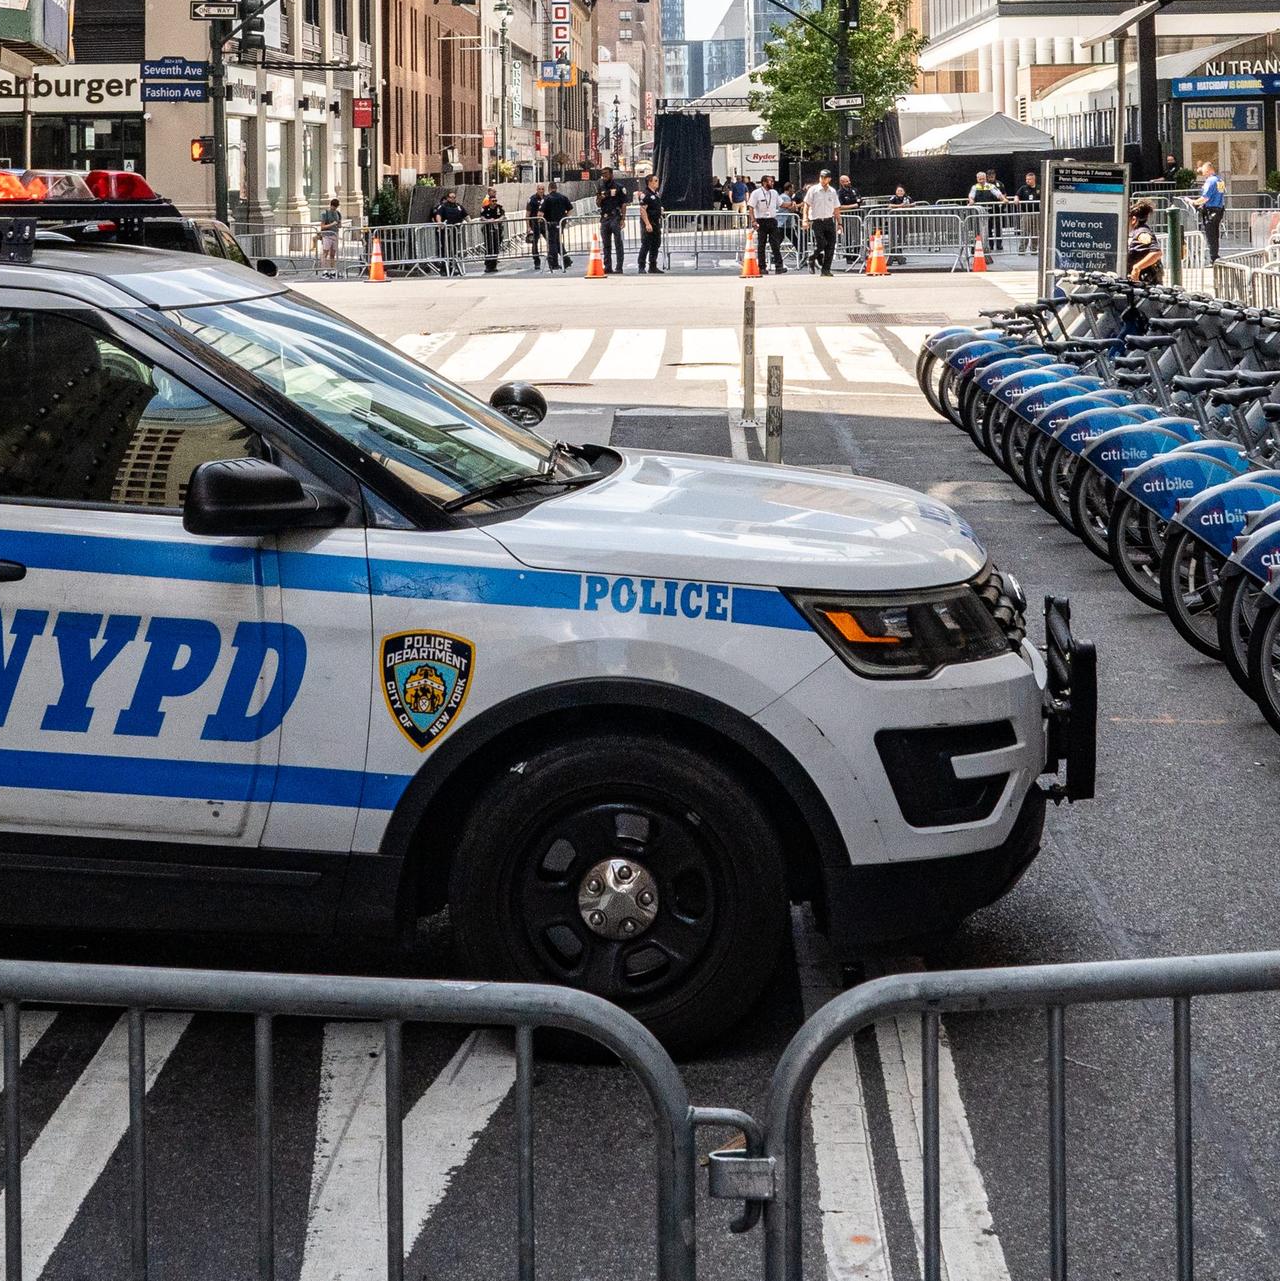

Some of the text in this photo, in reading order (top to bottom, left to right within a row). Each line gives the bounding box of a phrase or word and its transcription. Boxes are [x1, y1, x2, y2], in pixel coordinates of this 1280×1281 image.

[144, 65, 202, 75] Seventh Ave
[1206, 62, 1225, 76] NJ
[145, 87, 202, 98] Fashion Ave
[1187, 107, 1236, 119] MATCHDAY
[1187, 119, 1197, 130] IS
[752, 152, 777, 161] Ryder
[125, 162, 132, 170] A
[1060, 220, 1103, 229] We're not
[1060, 230, 1093, 239] writers,
[1061, 240, 1075, 248] but
[1092, 240, 1111, 250] help
[1078, 250, 1105, 259] clients
[1086, 260, 1106, 269] their
[1166, 478, 1194, 490] bike
[1225, 509, 1247, 524] bik
[584, 575, 729, 621] POLICE
[404, 636, 453, 652] POLICE
[386, 648, 468, 671] DEPARTMENT
[386, 681, 413, 728] CITY OF
[429, 678, 467, 736] NEW YORK
